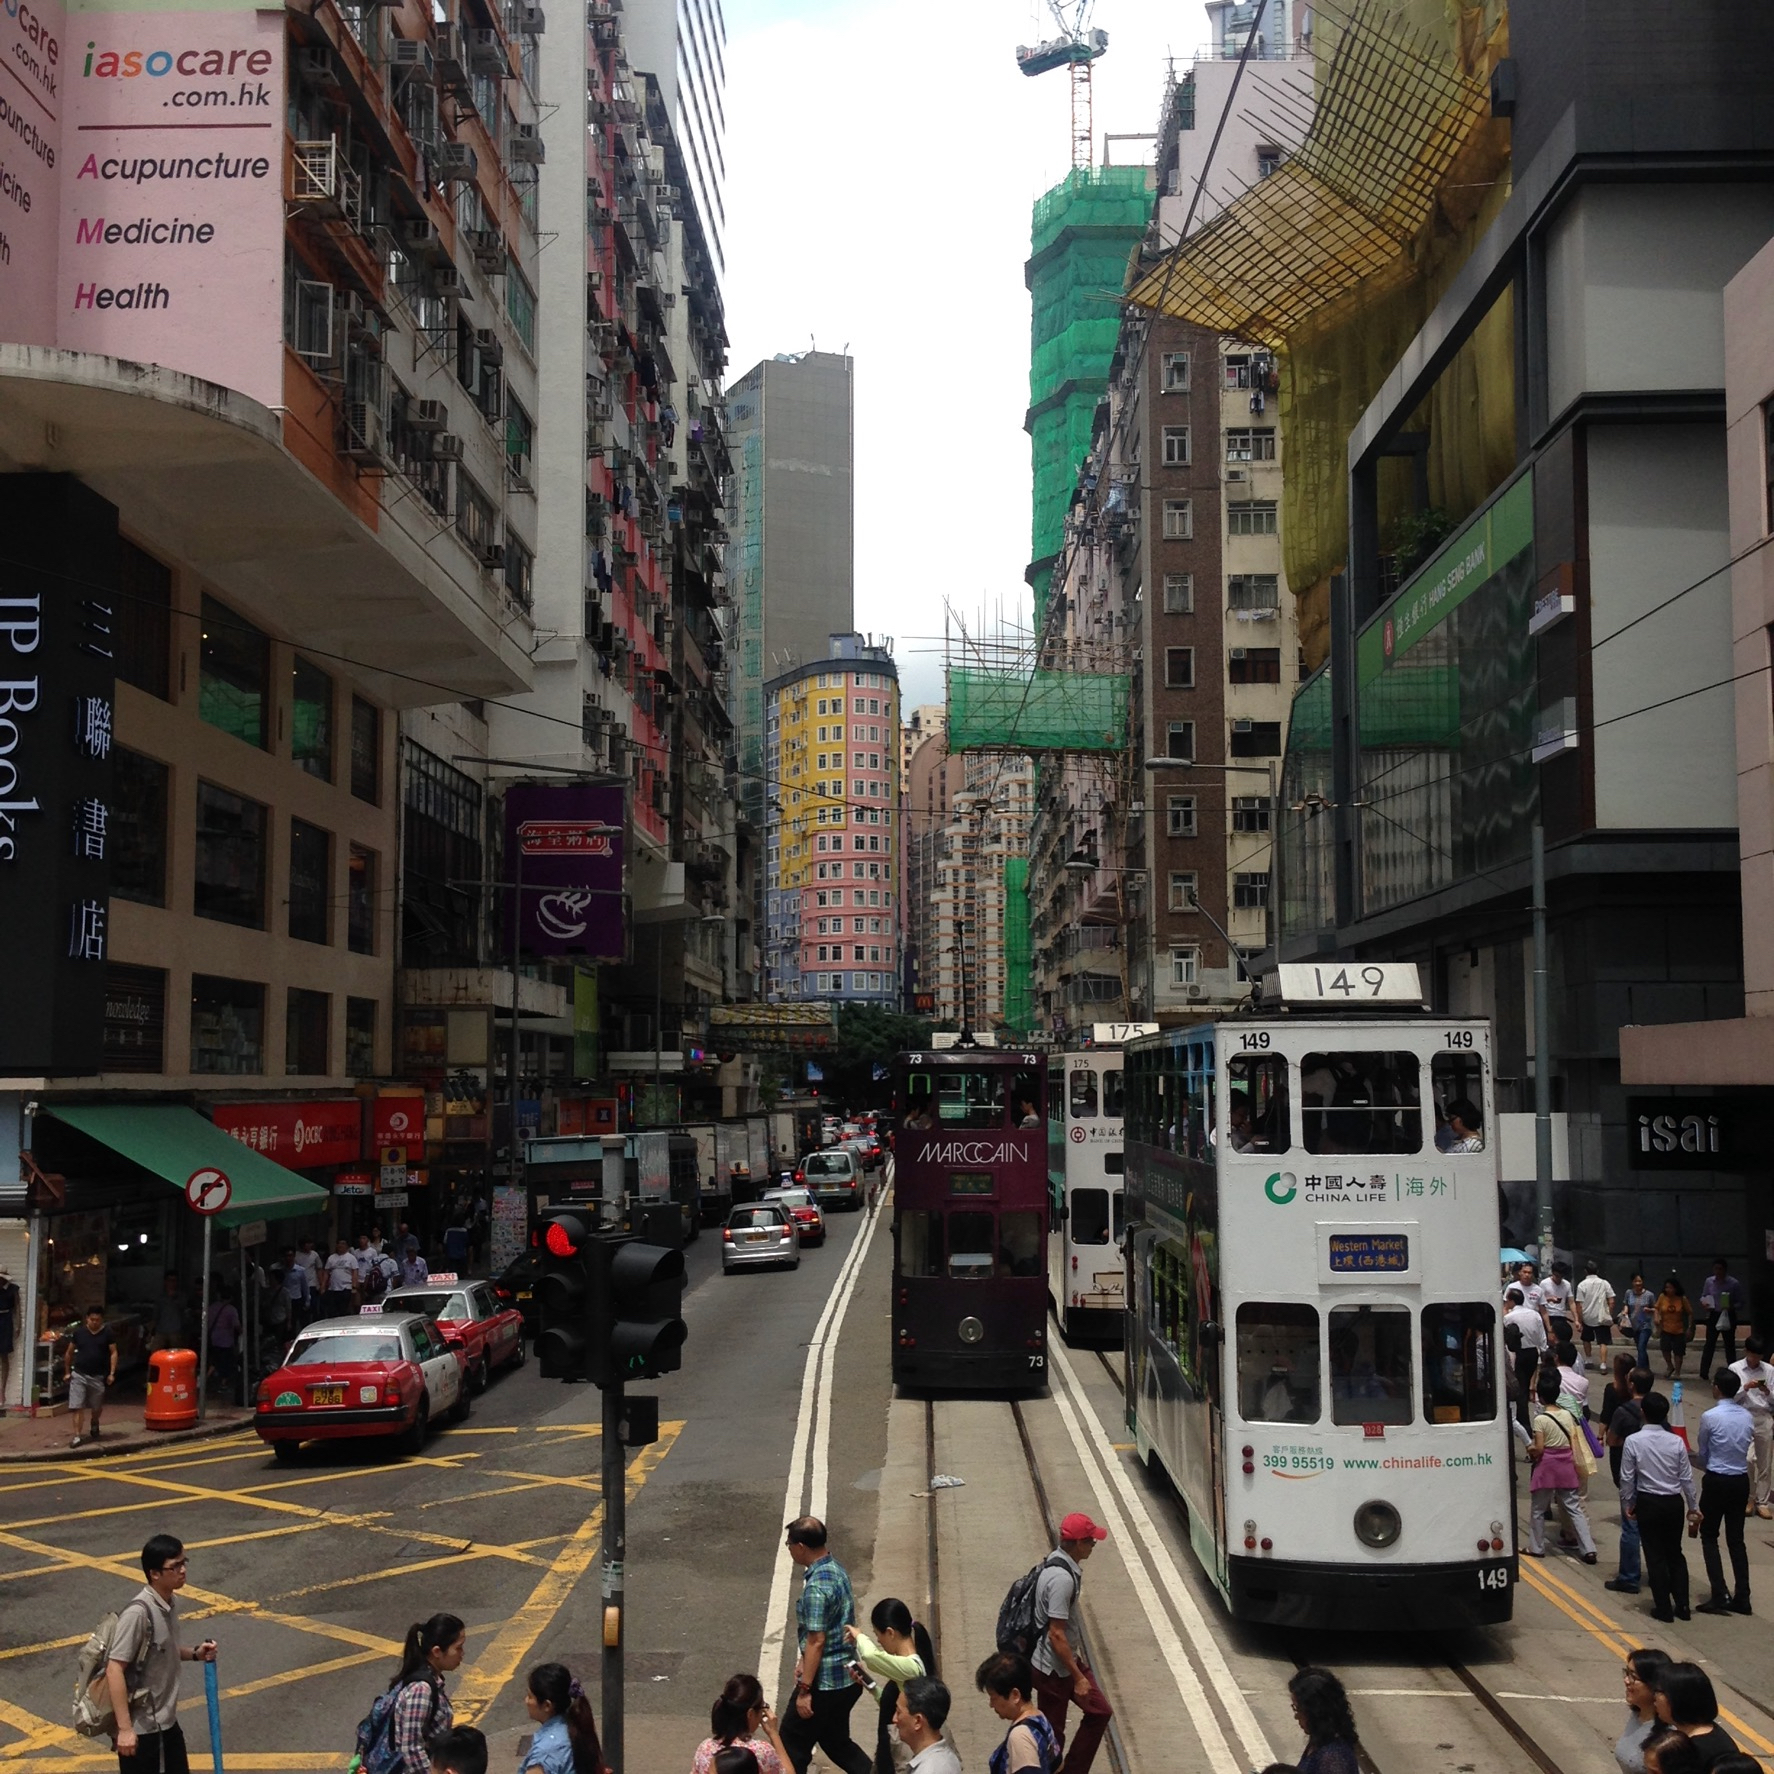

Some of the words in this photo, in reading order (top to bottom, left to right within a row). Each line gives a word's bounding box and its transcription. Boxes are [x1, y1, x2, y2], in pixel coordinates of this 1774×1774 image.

[83, 41, 272, 77] iasocare
[12, 42, 56, 98] .com.hk
[163, 83, 271, 107] .com.hk
[77, 152, 269, 185] Acupuncture
[76, 218, 215, 244] Medicine
[74, 283, 170, 309] Health
[1466, 541, 1485, 576] BANK
[1315, 966, 1384, 996] 149
[1109, 1024, 1144, 1040] 175
[1239, 1032, 1270, 1049] 149
[1444, 1031, 1473, 1048] 149
[909, 1054, 922, 1064] 73
[1022, 1054, 1036, 1064] 73
[1073, 1059, 1089, 1068] 175
[304, 1125, 323, 1145] OCBC
[1638, 1115, 1720, 1152] isai
[1304, 1174, 1387, 1191] 中國人壽
[1405, 1176, 1448, 1197] 海外
[1305, 1194, 1350, 1202] CHINA
[1356, 1193, 1386, 1202] LIFE
[1331, 1240, 1368, 1252] Western
[1371, 1239, 1403, 1250] Market
[430, 1273, 455, 1281] TAXI
[1028, 1356, 1043, 1367] 73
[1263, 1455, 1287, 1468] 399
[1292, 1456, 1334, 1470] 95519
[1343, 1453, 1492, 1470] www.chinalife.com.hk
[1478, 1568, 1508, 1590] 149
